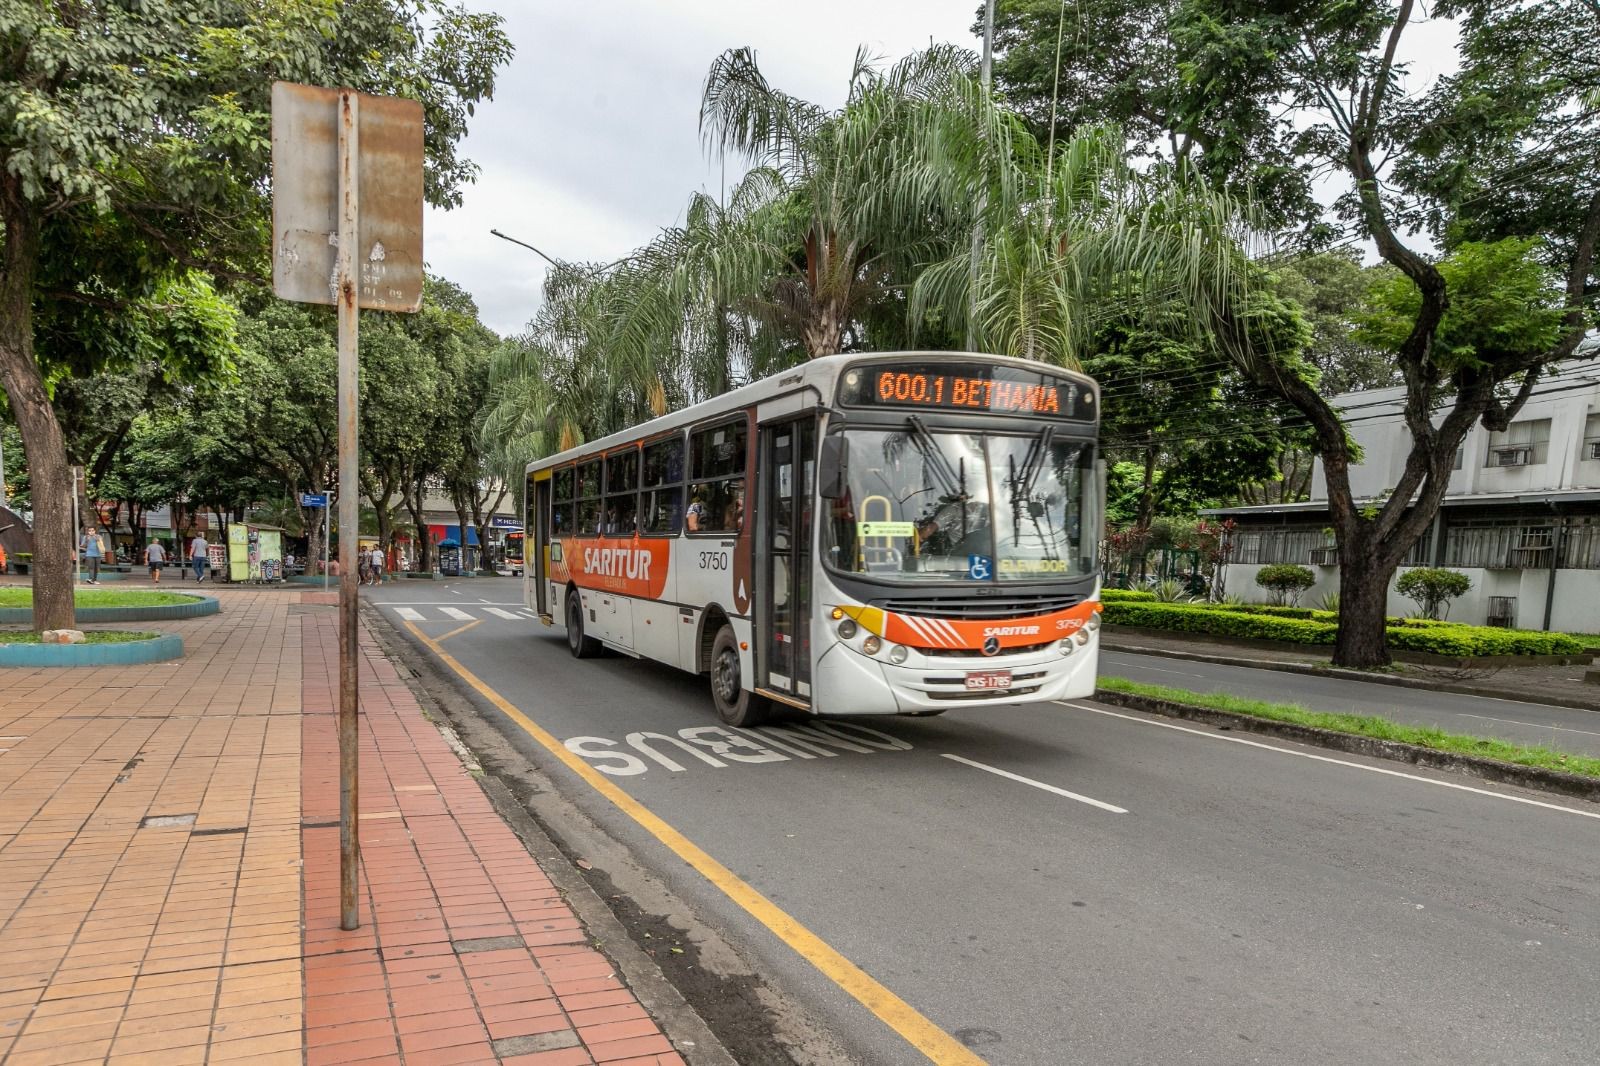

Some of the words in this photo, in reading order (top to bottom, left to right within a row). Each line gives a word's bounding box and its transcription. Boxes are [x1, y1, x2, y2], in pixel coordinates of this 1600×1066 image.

[879, 372, 944, 403] 600.1
[952, 379, 1059, 413] BETHANIA
[584, 547, 651, 581] SARITUR
[699, 551, 728, 570] 3750
[983, 625, 1041, 637] SARITUR
[1056, 618, 1084, 630] 3750
